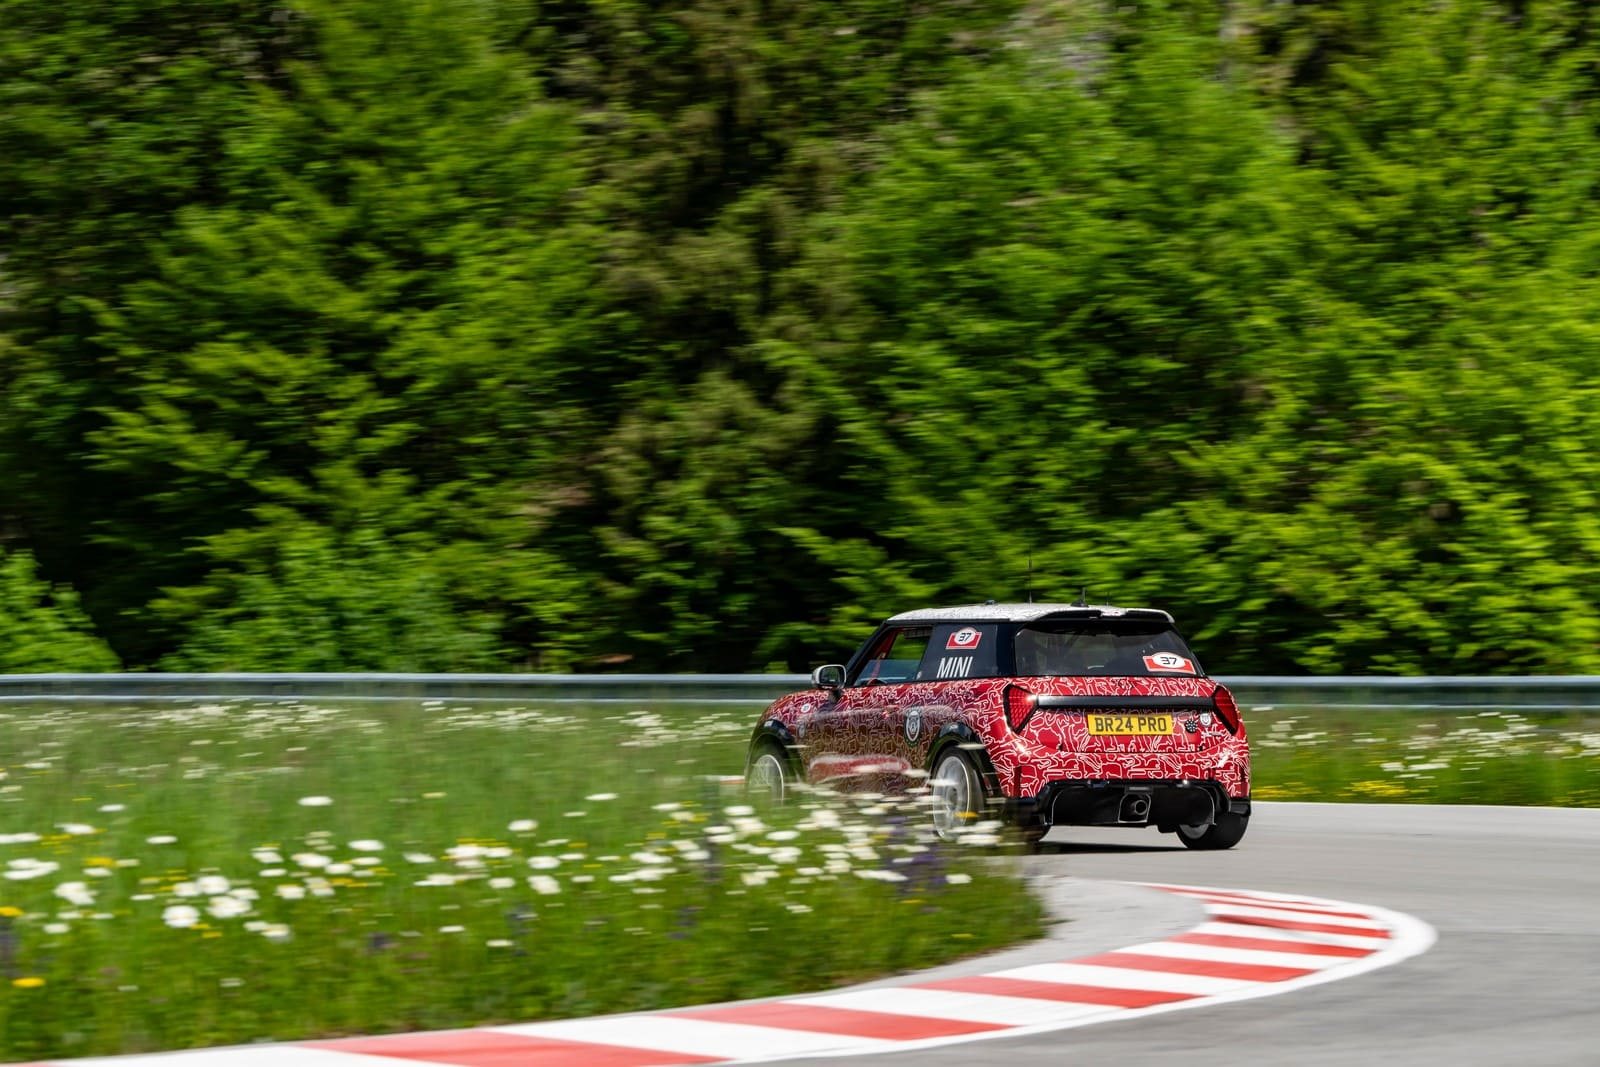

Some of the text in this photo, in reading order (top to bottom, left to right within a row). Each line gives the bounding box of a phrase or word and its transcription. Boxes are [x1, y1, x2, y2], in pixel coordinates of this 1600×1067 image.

[958, 632, 972, 642] 37
[1160, 656, 1177, 665] 37
[936, 656, 973, 679] MINI
[1094, 717, 1167, 732] BR24 PRO
